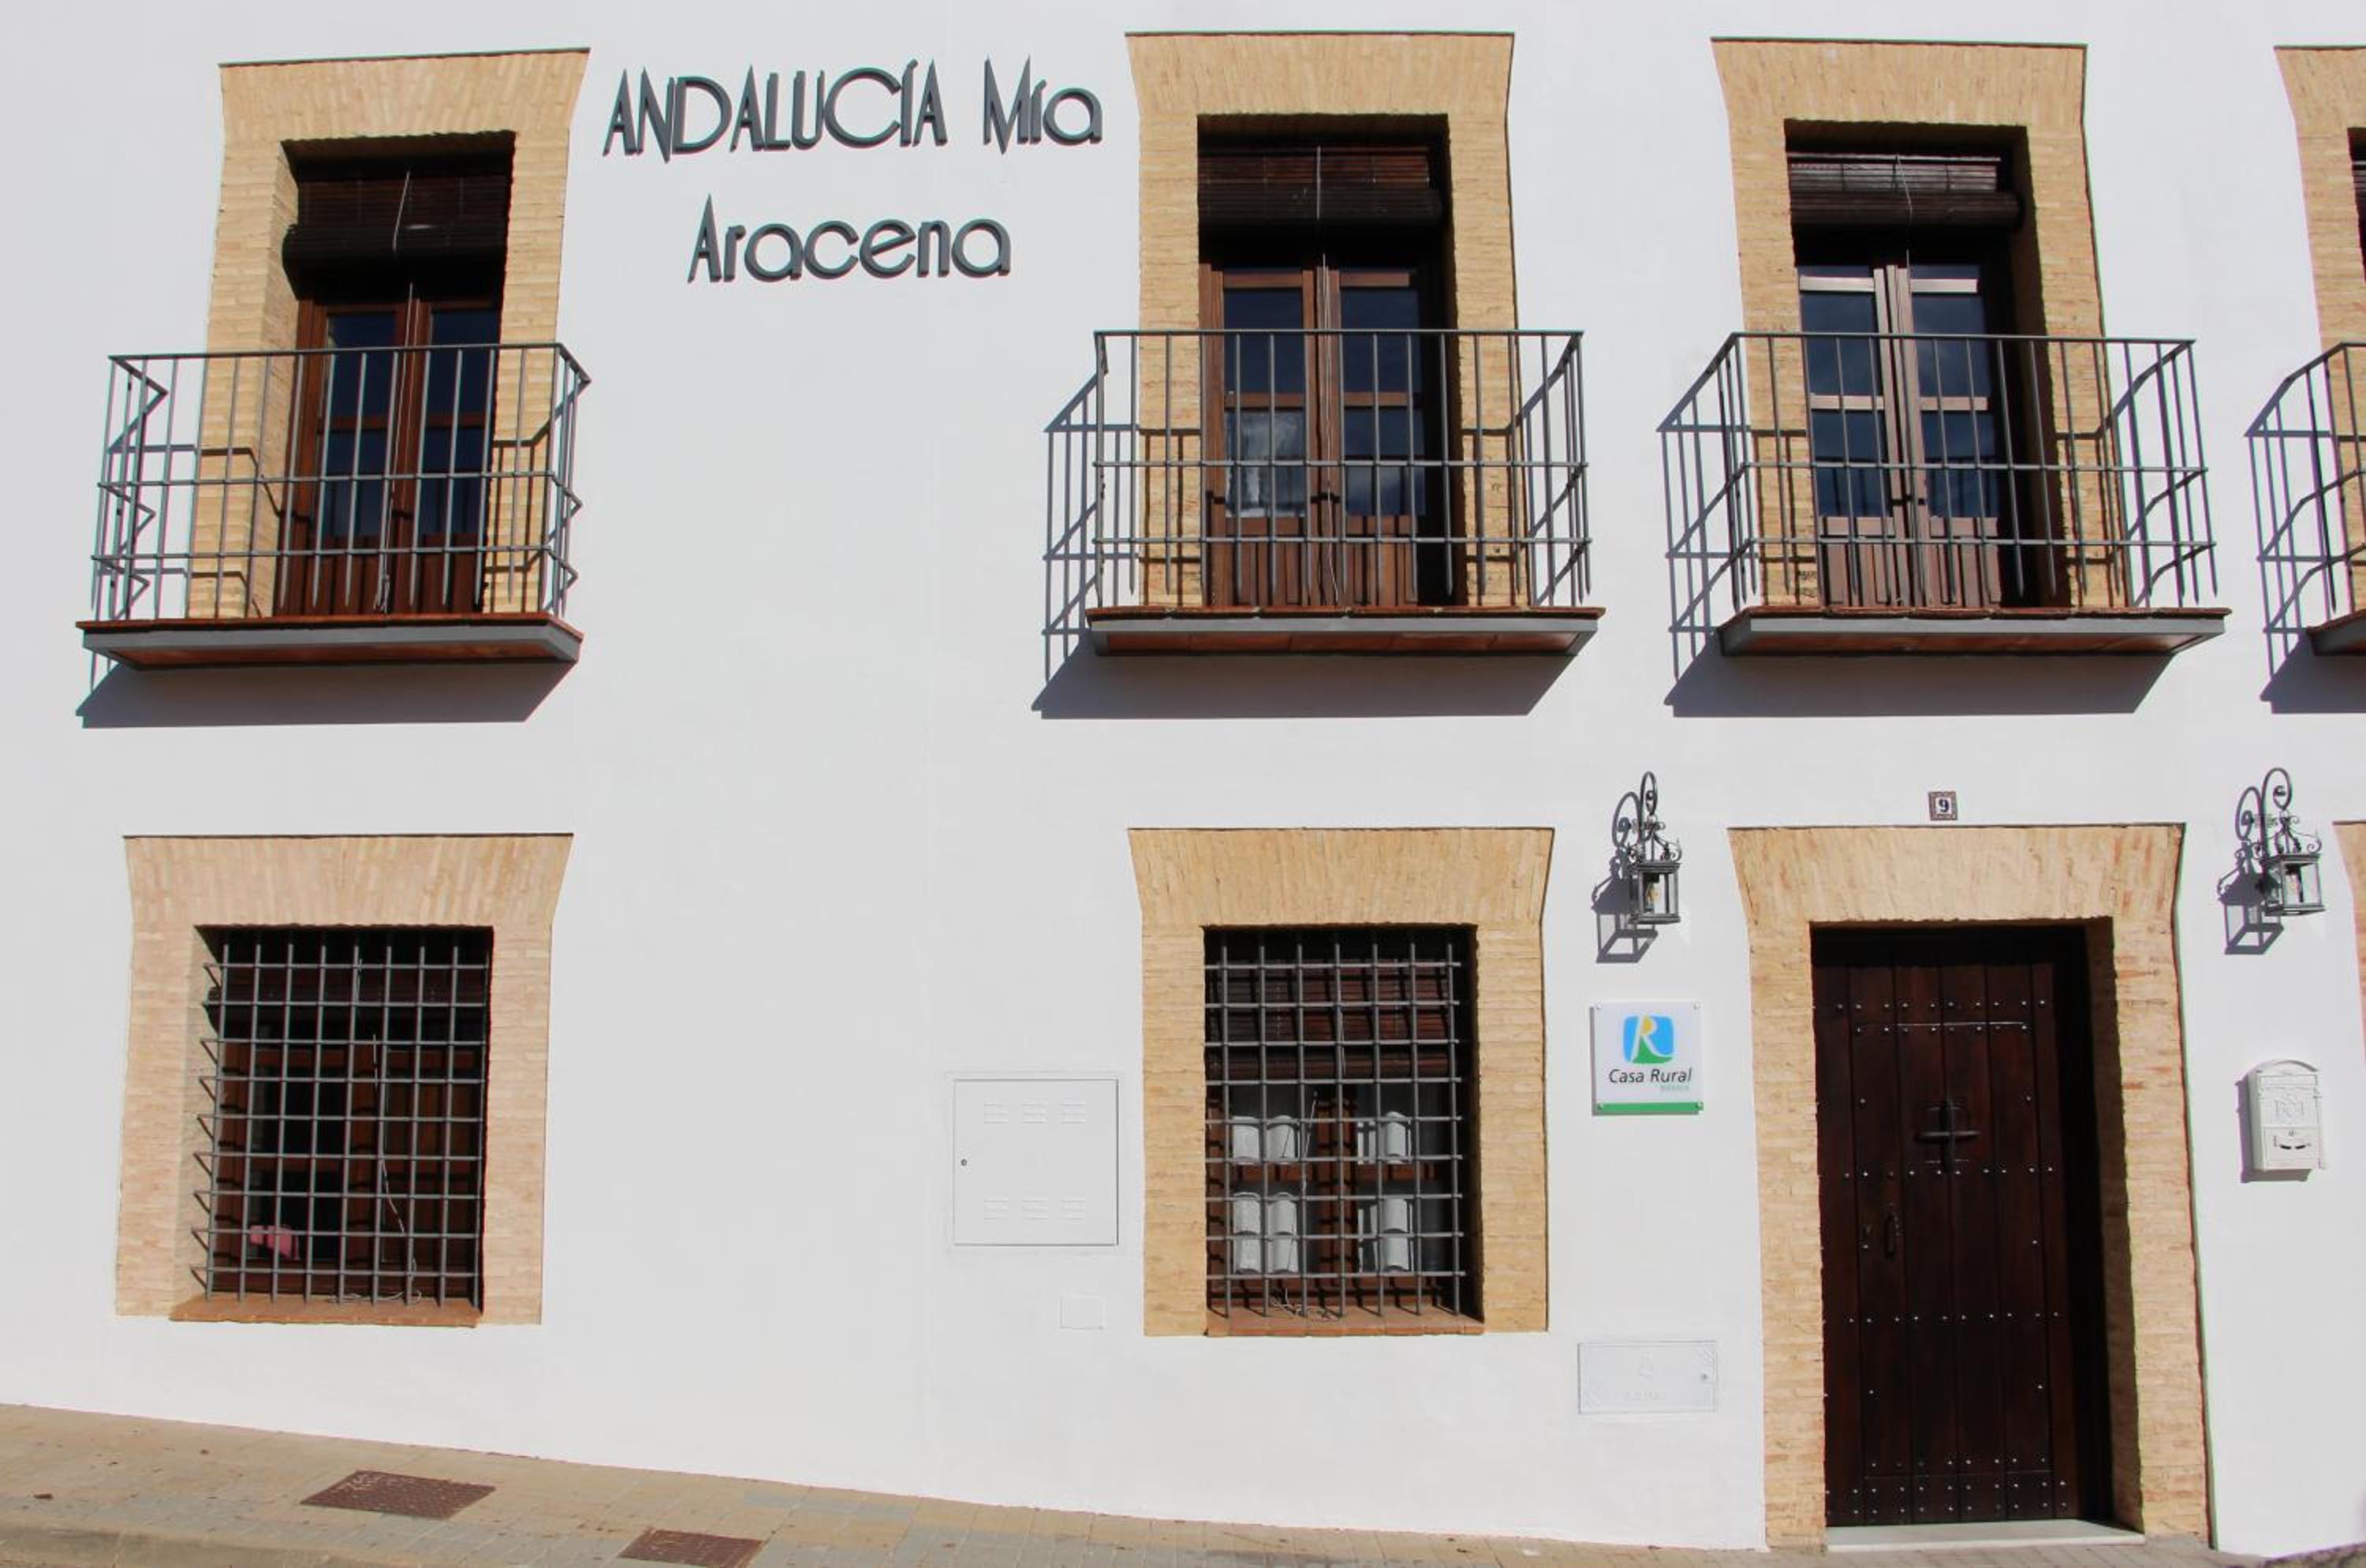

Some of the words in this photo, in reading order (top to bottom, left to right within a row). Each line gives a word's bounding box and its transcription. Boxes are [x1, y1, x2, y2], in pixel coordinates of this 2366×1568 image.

[603, 58, 947, 164] ANDALUCÍA
[983, 55, 1102, 155] Mía
[688, 194, 1011, 284] Aracena
[1939, 799, 1950, 813] 9
[1609, 1069, 1644, 1084] Casa
[1650, 1067, 1692, 1084] Rural
